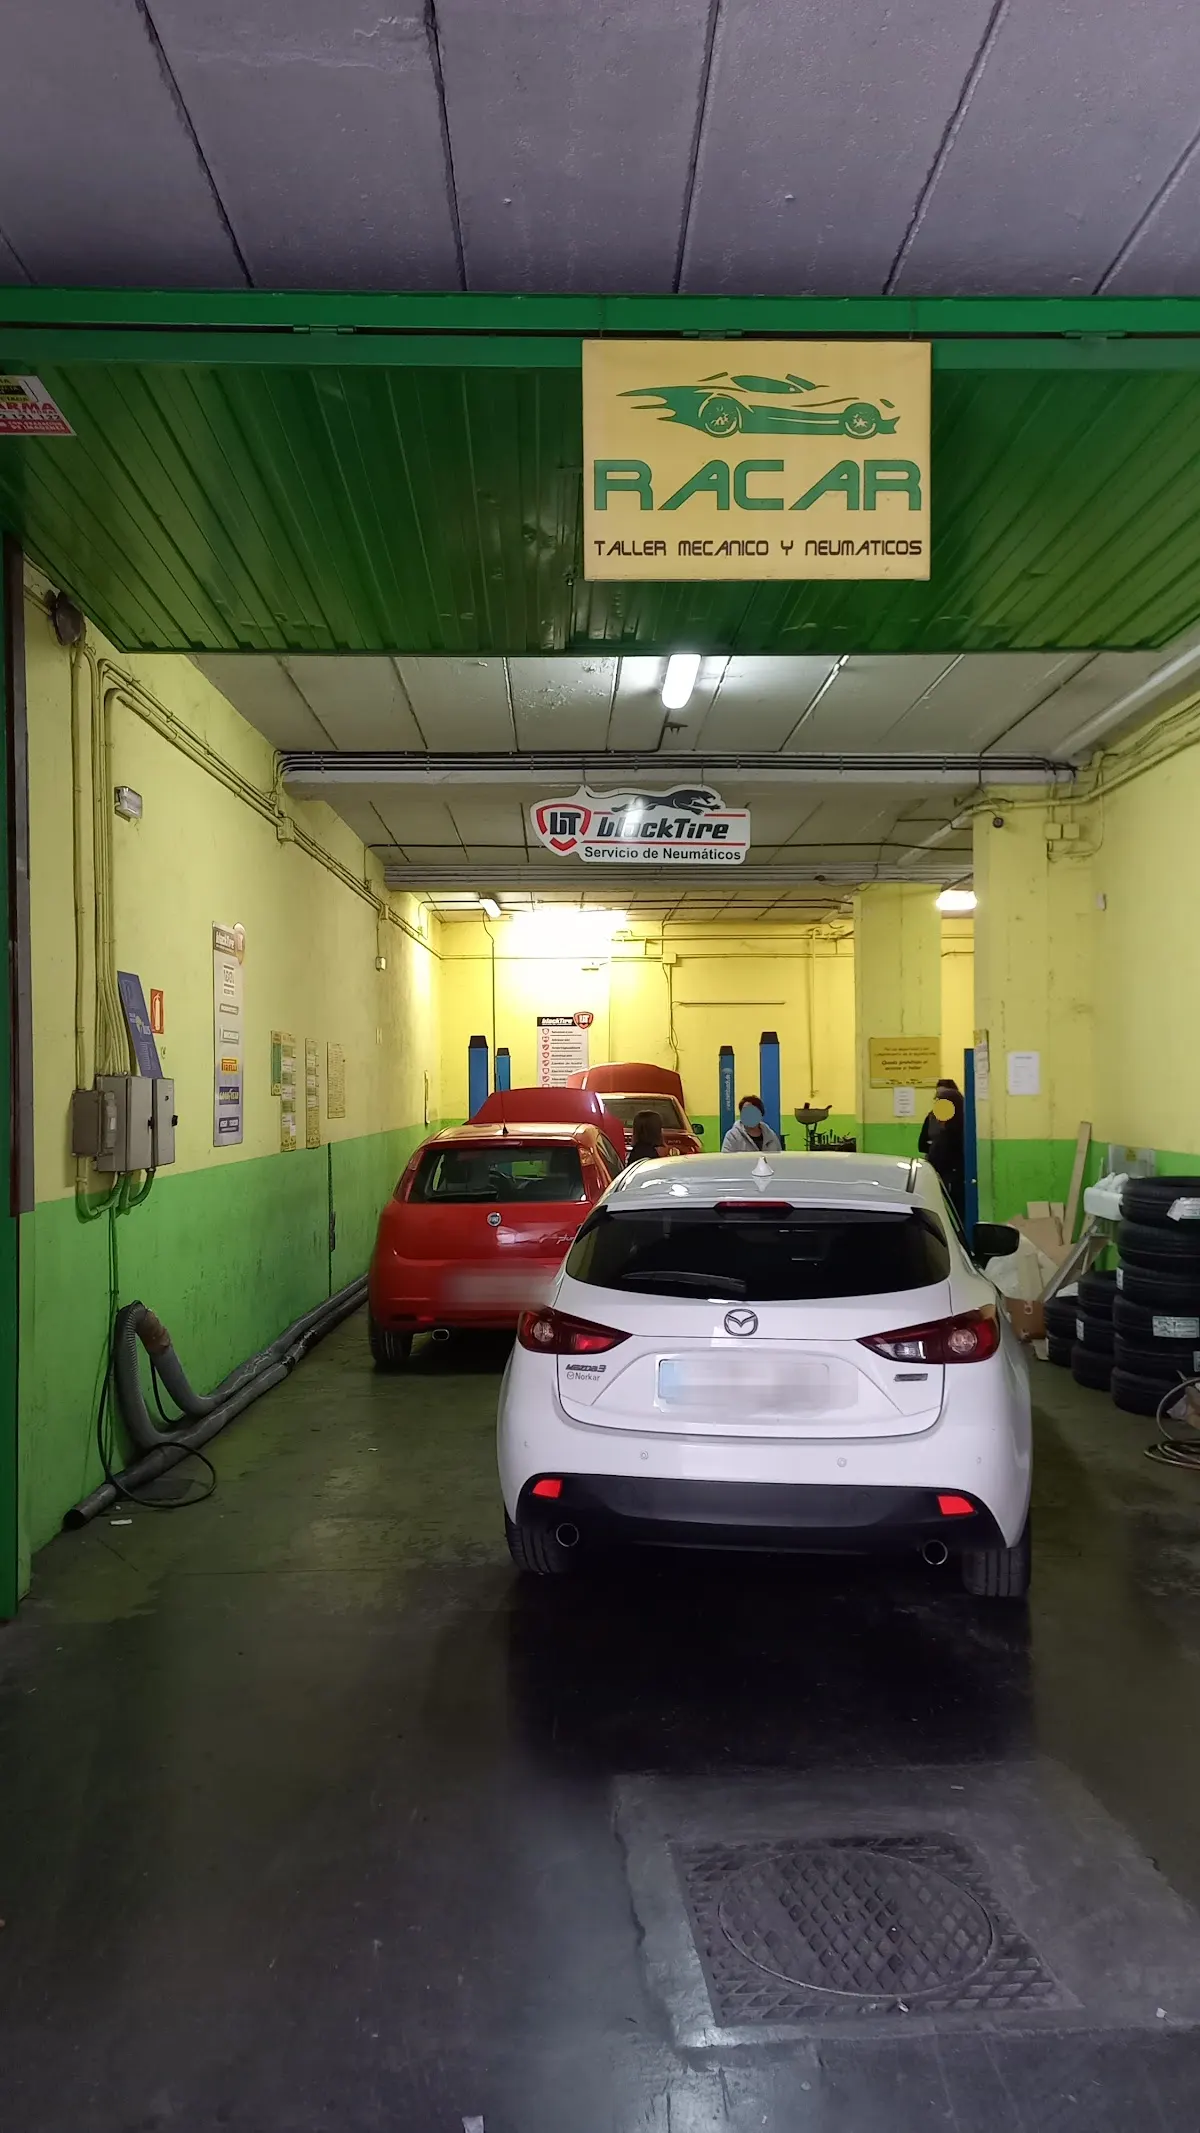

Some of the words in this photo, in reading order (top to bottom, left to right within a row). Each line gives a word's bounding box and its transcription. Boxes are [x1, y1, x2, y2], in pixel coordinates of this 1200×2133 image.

[594, 459, 921, 510] RACAR
[594, 540, 667, 556] TALLER
[678, 540, 769, 556] MECANICO
[781, 540, 794, 556] Y
[805, 540, 922, 556] NEUMATICOS
[584, 846, 638, 858] Servicio
[642, 847, 658, 859] de
[663, 847, 741, 860] Neumáticos
